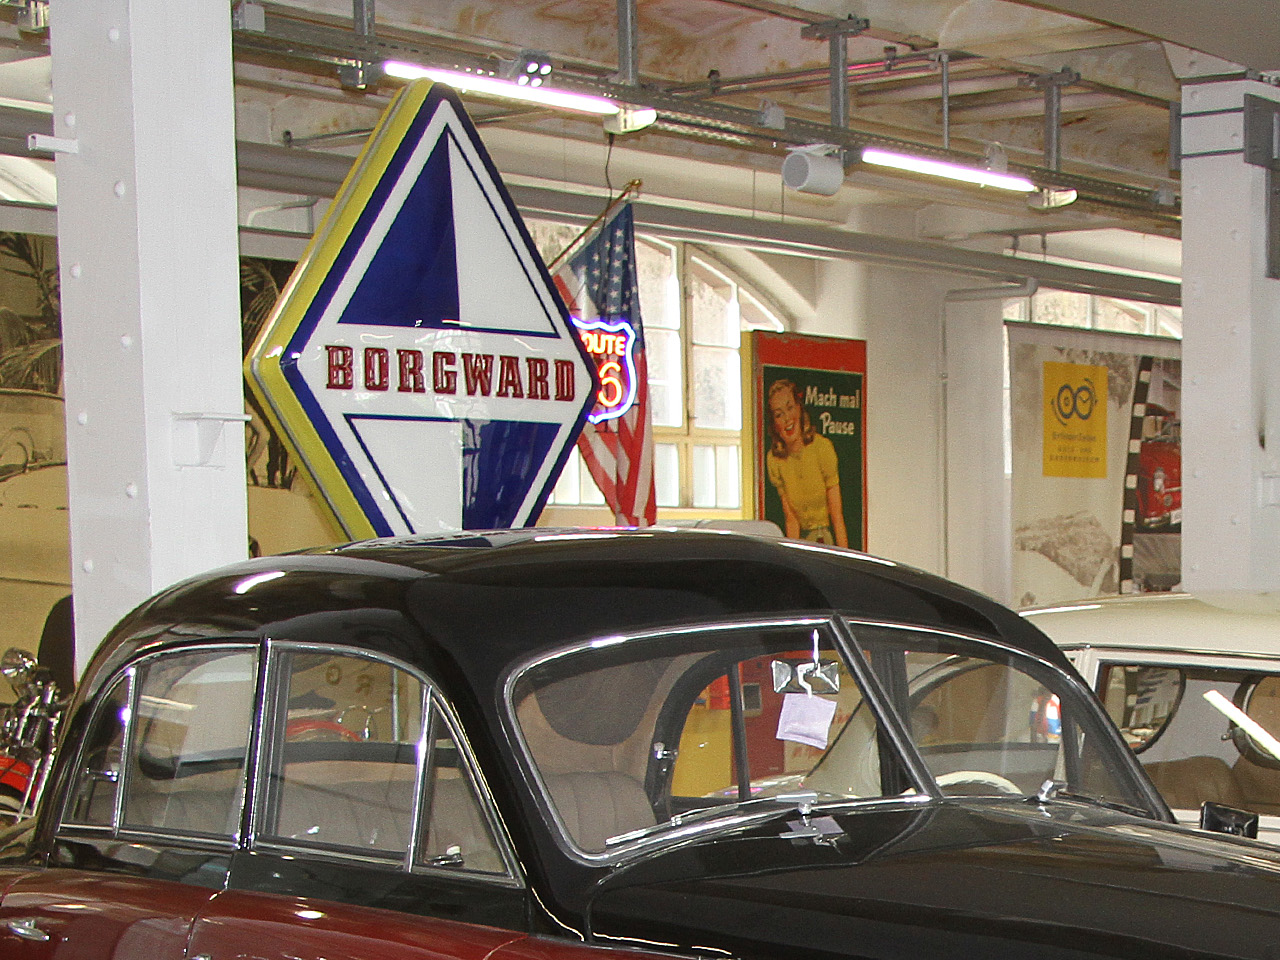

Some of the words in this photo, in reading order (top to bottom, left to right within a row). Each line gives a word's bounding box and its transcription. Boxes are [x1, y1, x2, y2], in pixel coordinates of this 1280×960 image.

[325, 345, 575, 401] BORGWARD
[805, 385, 837, 407] Mach
[839, 389, 860, 408] mal
[819, 411, 855, 435] Pause
